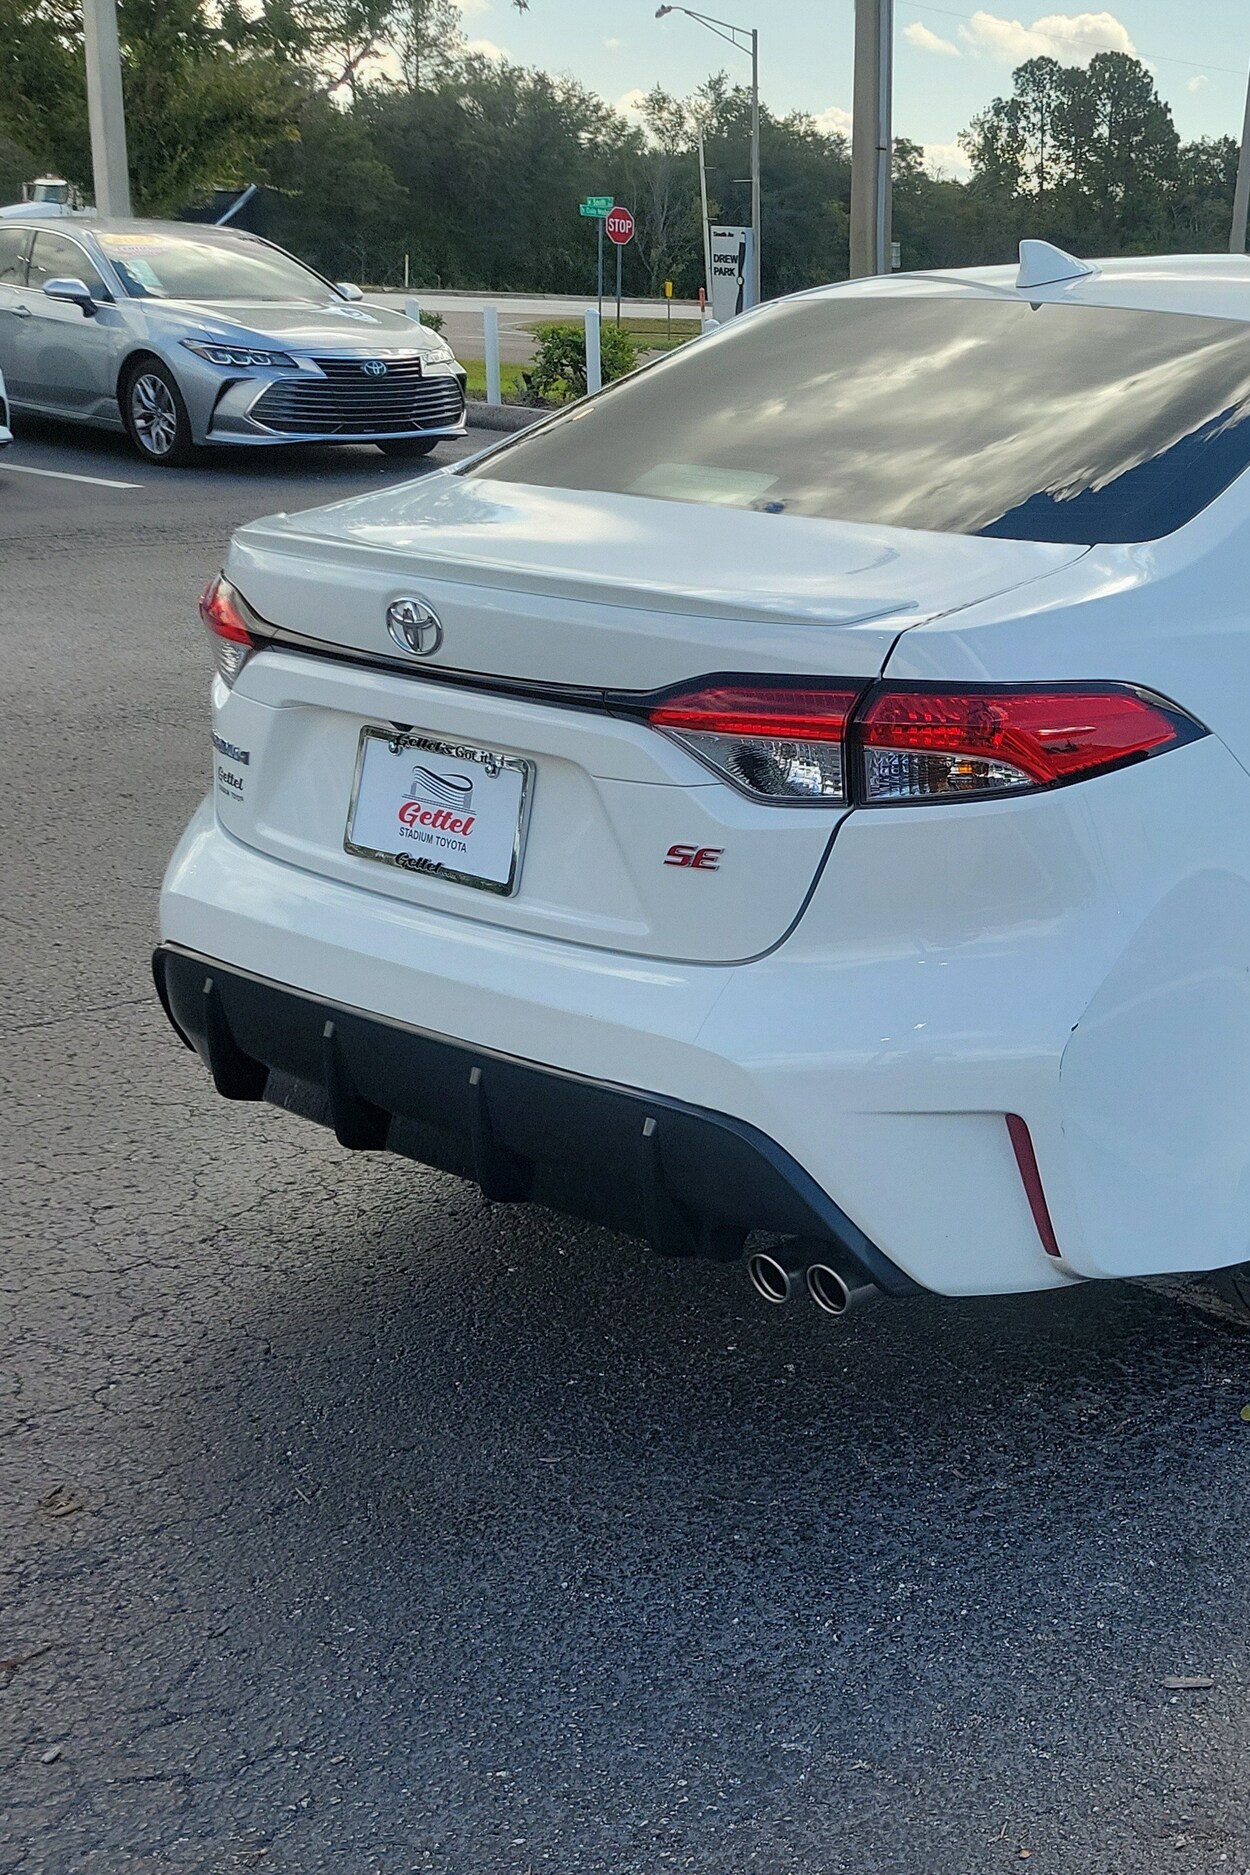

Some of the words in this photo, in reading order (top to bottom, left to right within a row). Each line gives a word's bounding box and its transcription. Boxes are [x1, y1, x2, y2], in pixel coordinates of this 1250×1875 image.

[608, 218, 632, 234] STOP
[714, 254, 738, 264] DREW
[714, 267, 736, 277] PARK
[456, 745, 479, 761] Got
[398, 801, 476, 836] Gettel
[399, 826, 433, 844] STADIUM
[436, 835, 467, 853] TOYOTA
[663, 842, 726, 872] SE
